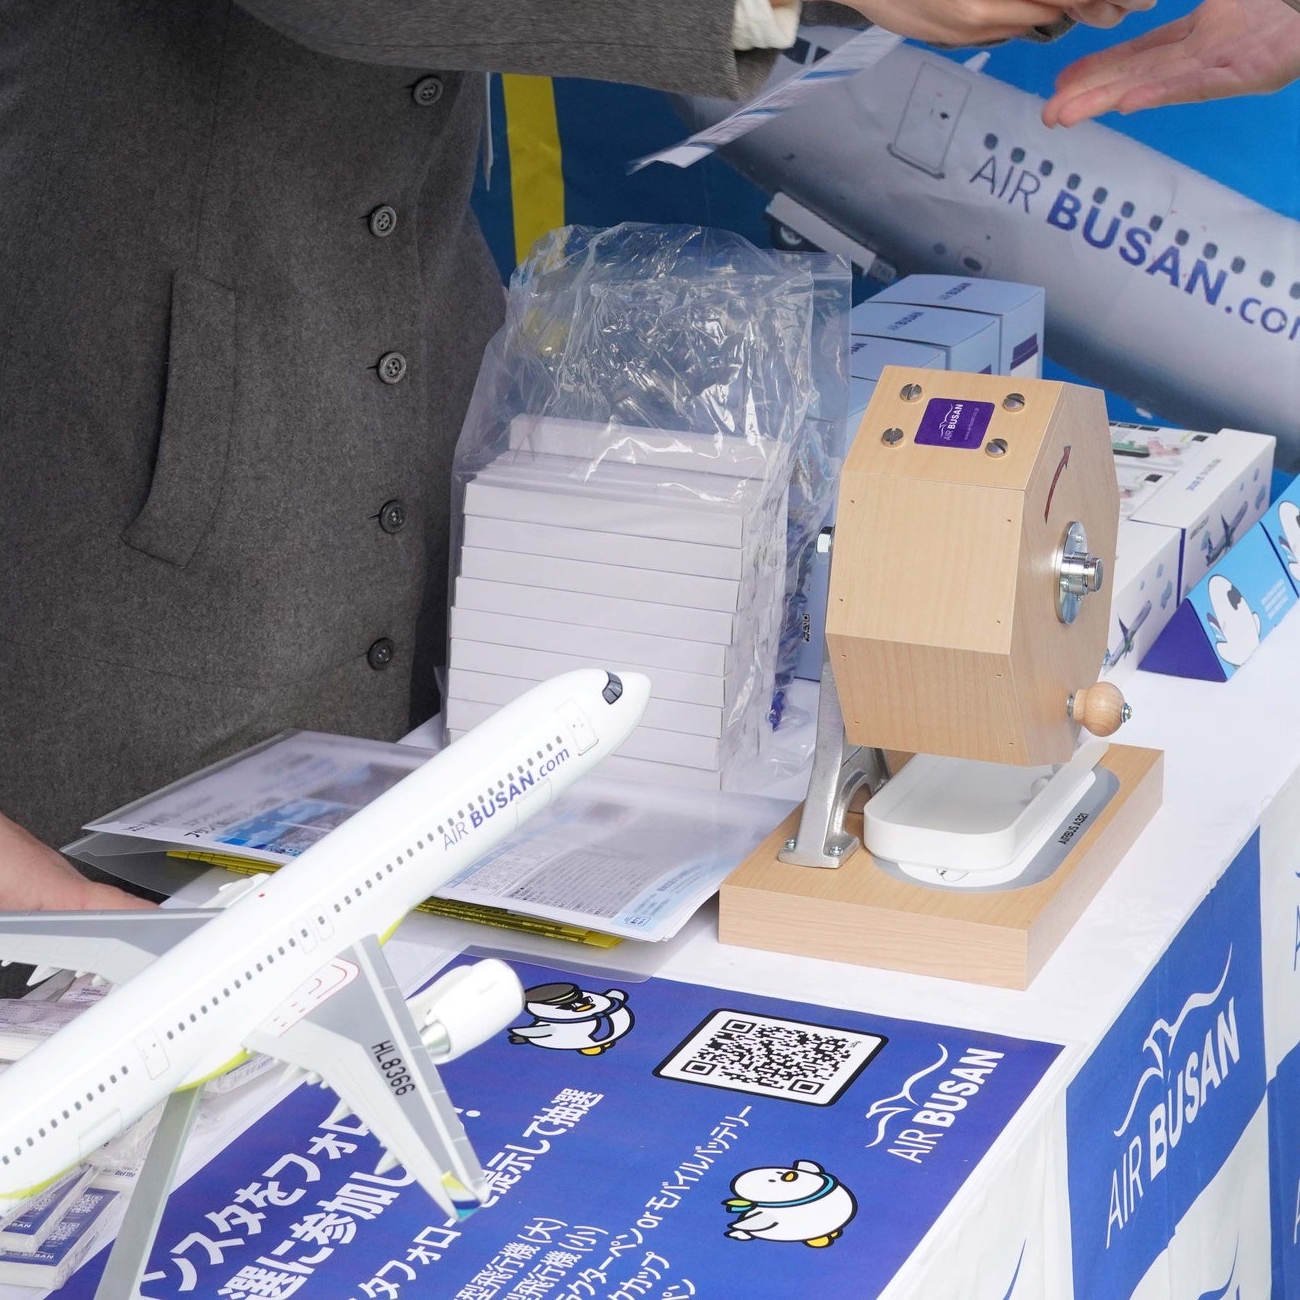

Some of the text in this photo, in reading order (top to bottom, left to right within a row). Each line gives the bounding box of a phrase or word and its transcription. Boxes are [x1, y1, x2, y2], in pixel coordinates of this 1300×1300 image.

[969, 154, 1042, 214] AIR
[947, 404, 964, 430] BUSAN
[443, 748, 570, 851] AIR BUSAN.com
[371, 1040, 416, 1096] HL8366
[887, 1047, 1005, 1164] AIR BUSAN
[646, 1105, 753, 1212] モバイルバッテリー
[1106, 996, 1241, 1250] AIR BUSAN
[138, 1114, 372, 1300] ンスタをフォロ
[636, 1211, 664, 1230] or
